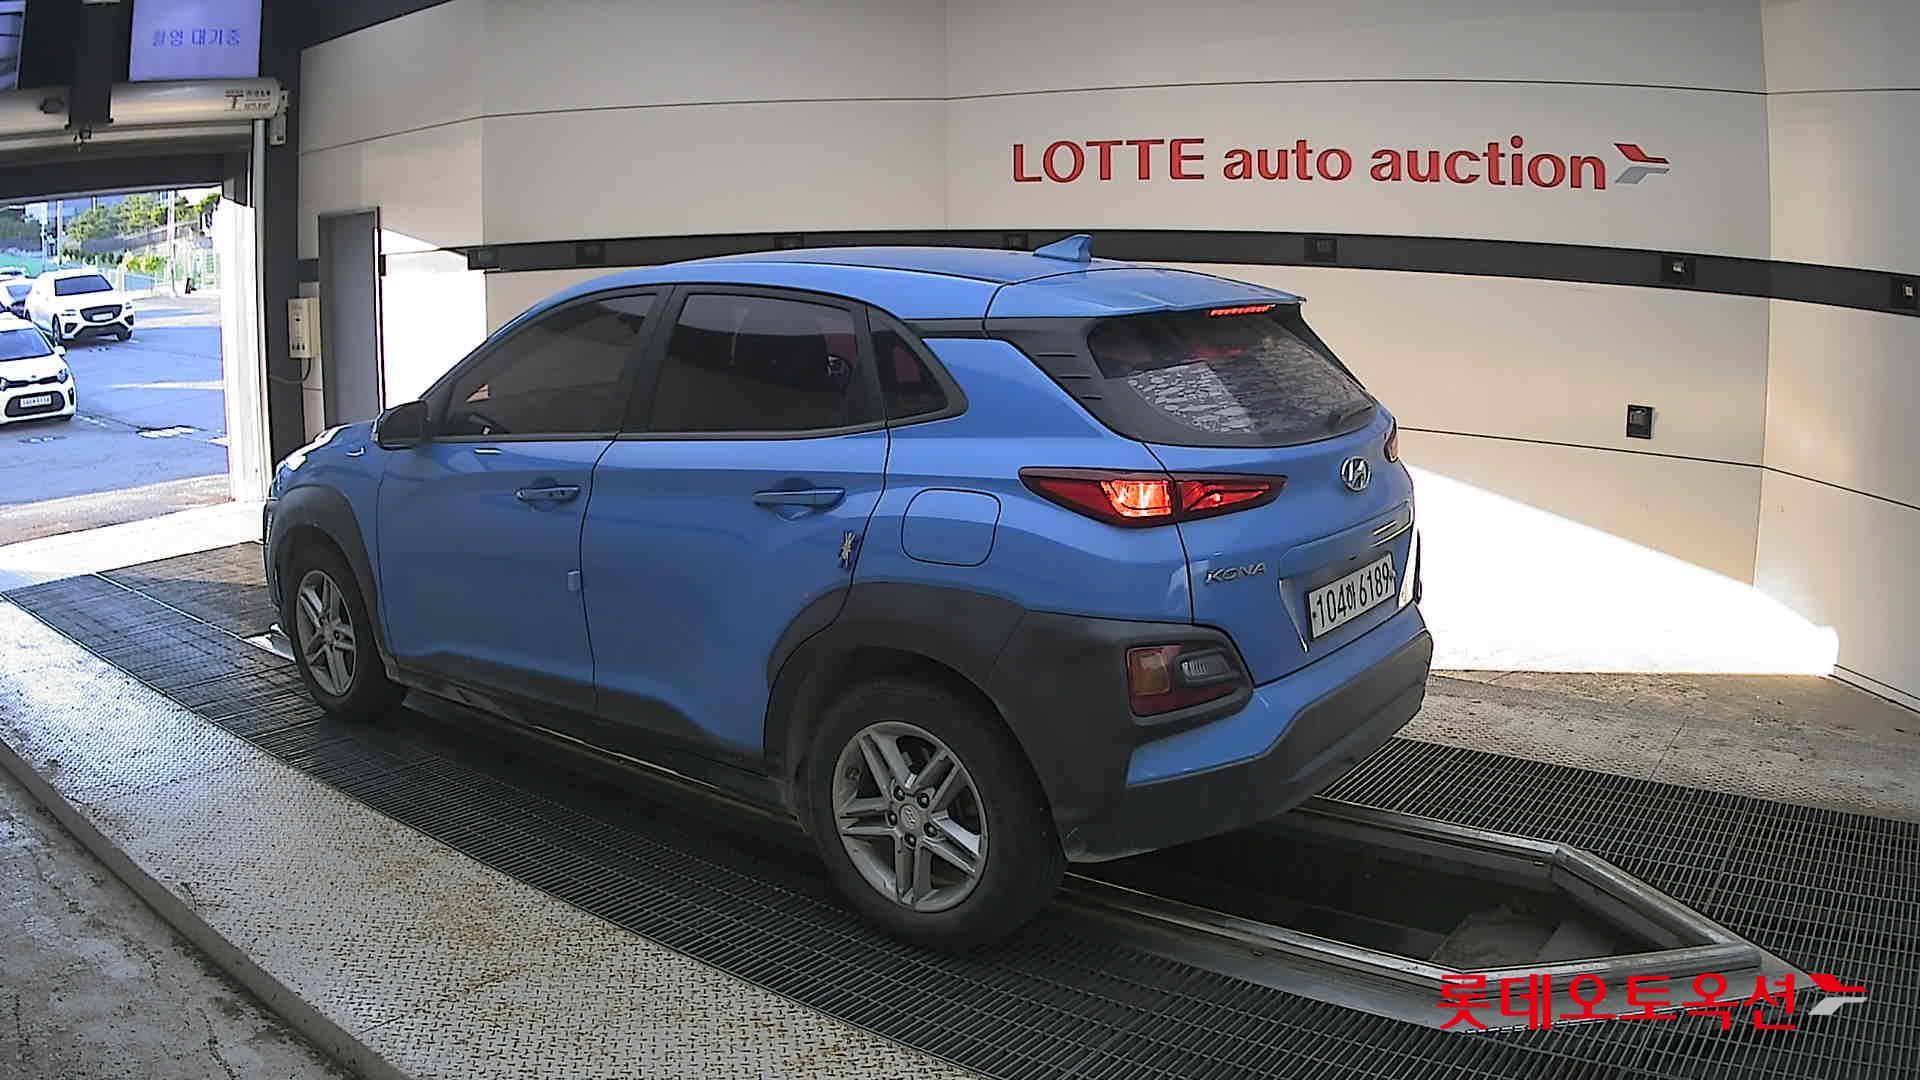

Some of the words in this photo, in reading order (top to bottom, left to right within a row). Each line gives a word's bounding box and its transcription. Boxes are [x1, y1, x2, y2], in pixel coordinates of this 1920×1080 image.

[1012, 138, 1206, 183] LOTTE
[1223, 139, 1354, 182] auto
[1370, 135, 1607, 191] auction
[1206, 562, 1266, 584] KONA
